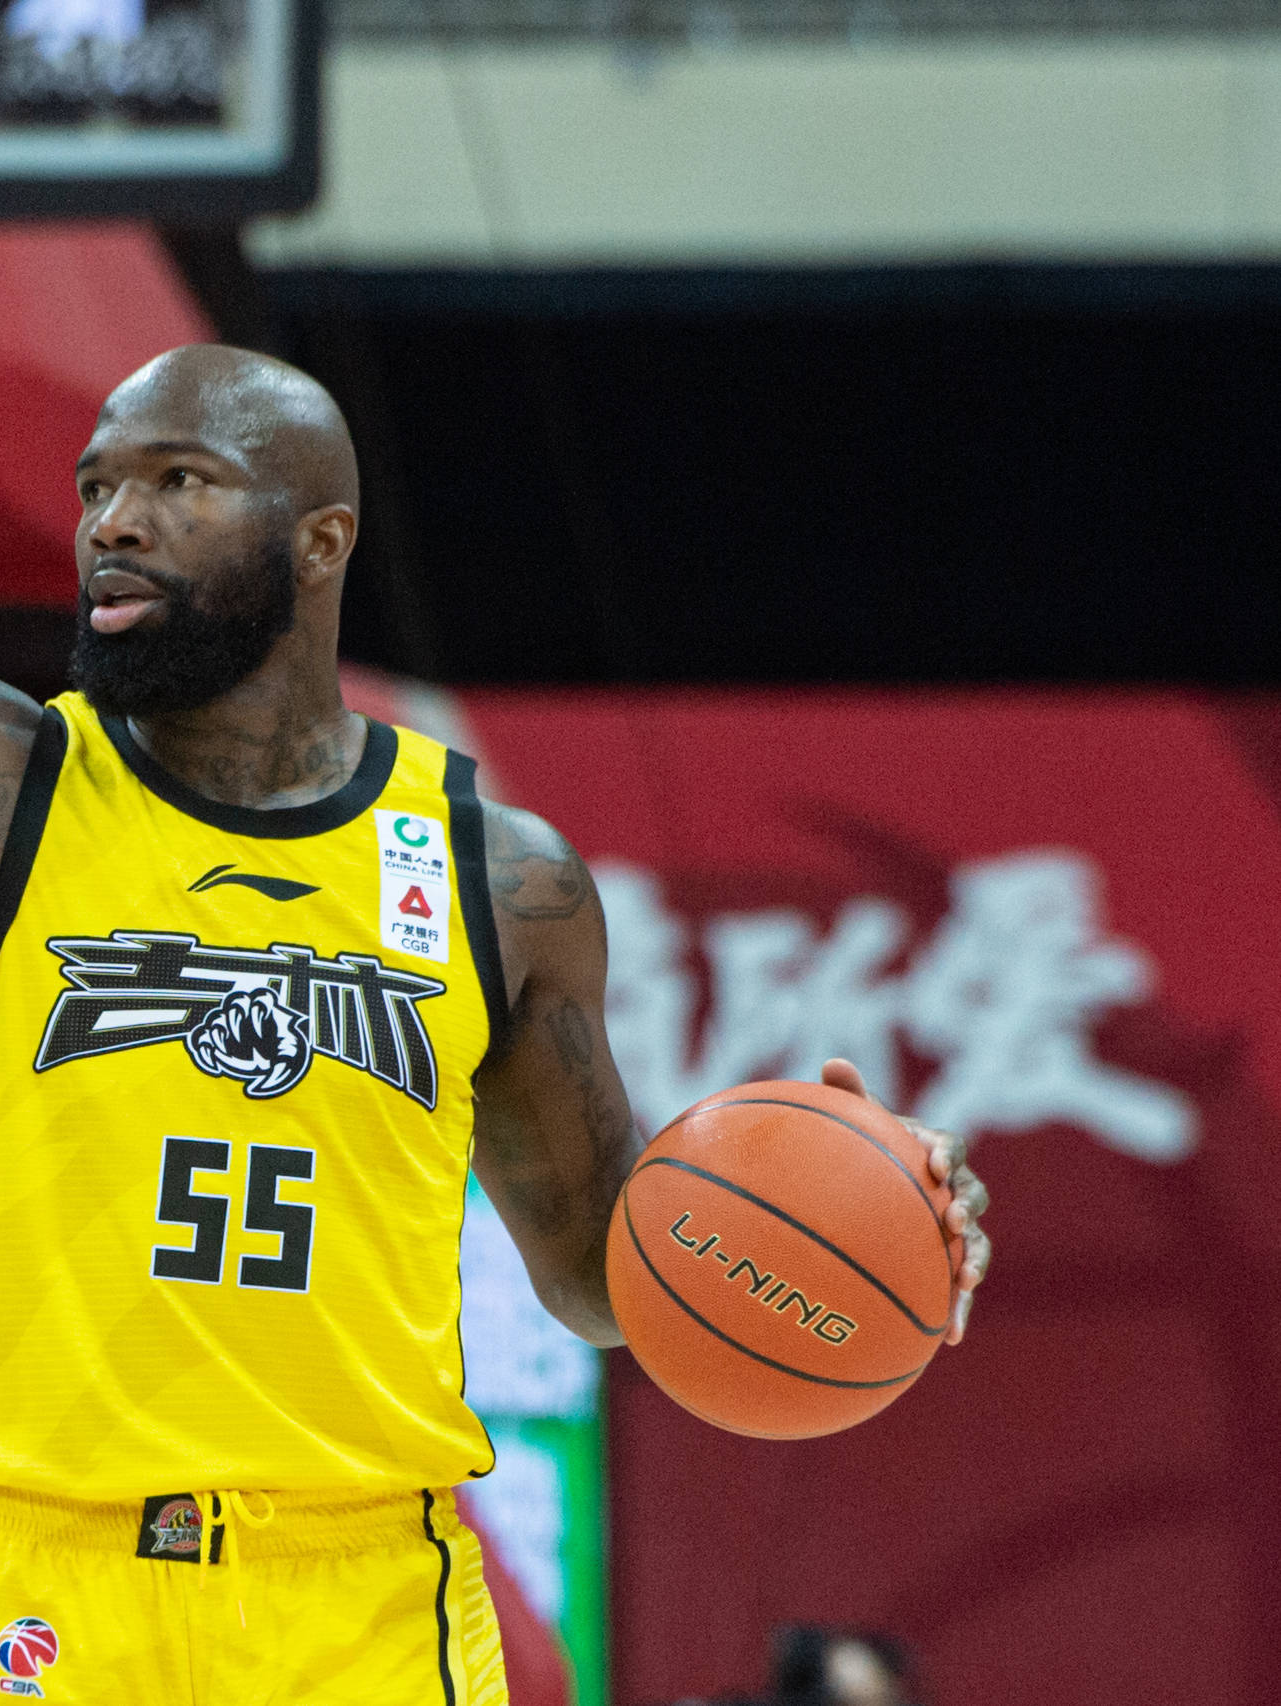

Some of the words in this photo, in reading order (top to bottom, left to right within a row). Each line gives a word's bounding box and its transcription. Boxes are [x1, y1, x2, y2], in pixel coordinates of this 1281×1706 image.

[385, 848, 443, 870] 中国人寿
[385, 861, 419, 872] CHINA
[422, 866, 443, 878] LIFE
[391, 922, 439, 942] 广发银行
[401, 938, 430, 954] CGB
[150, 1135, 317, 1293] 55
[669, 1211, 858, 1346] LI-NING
